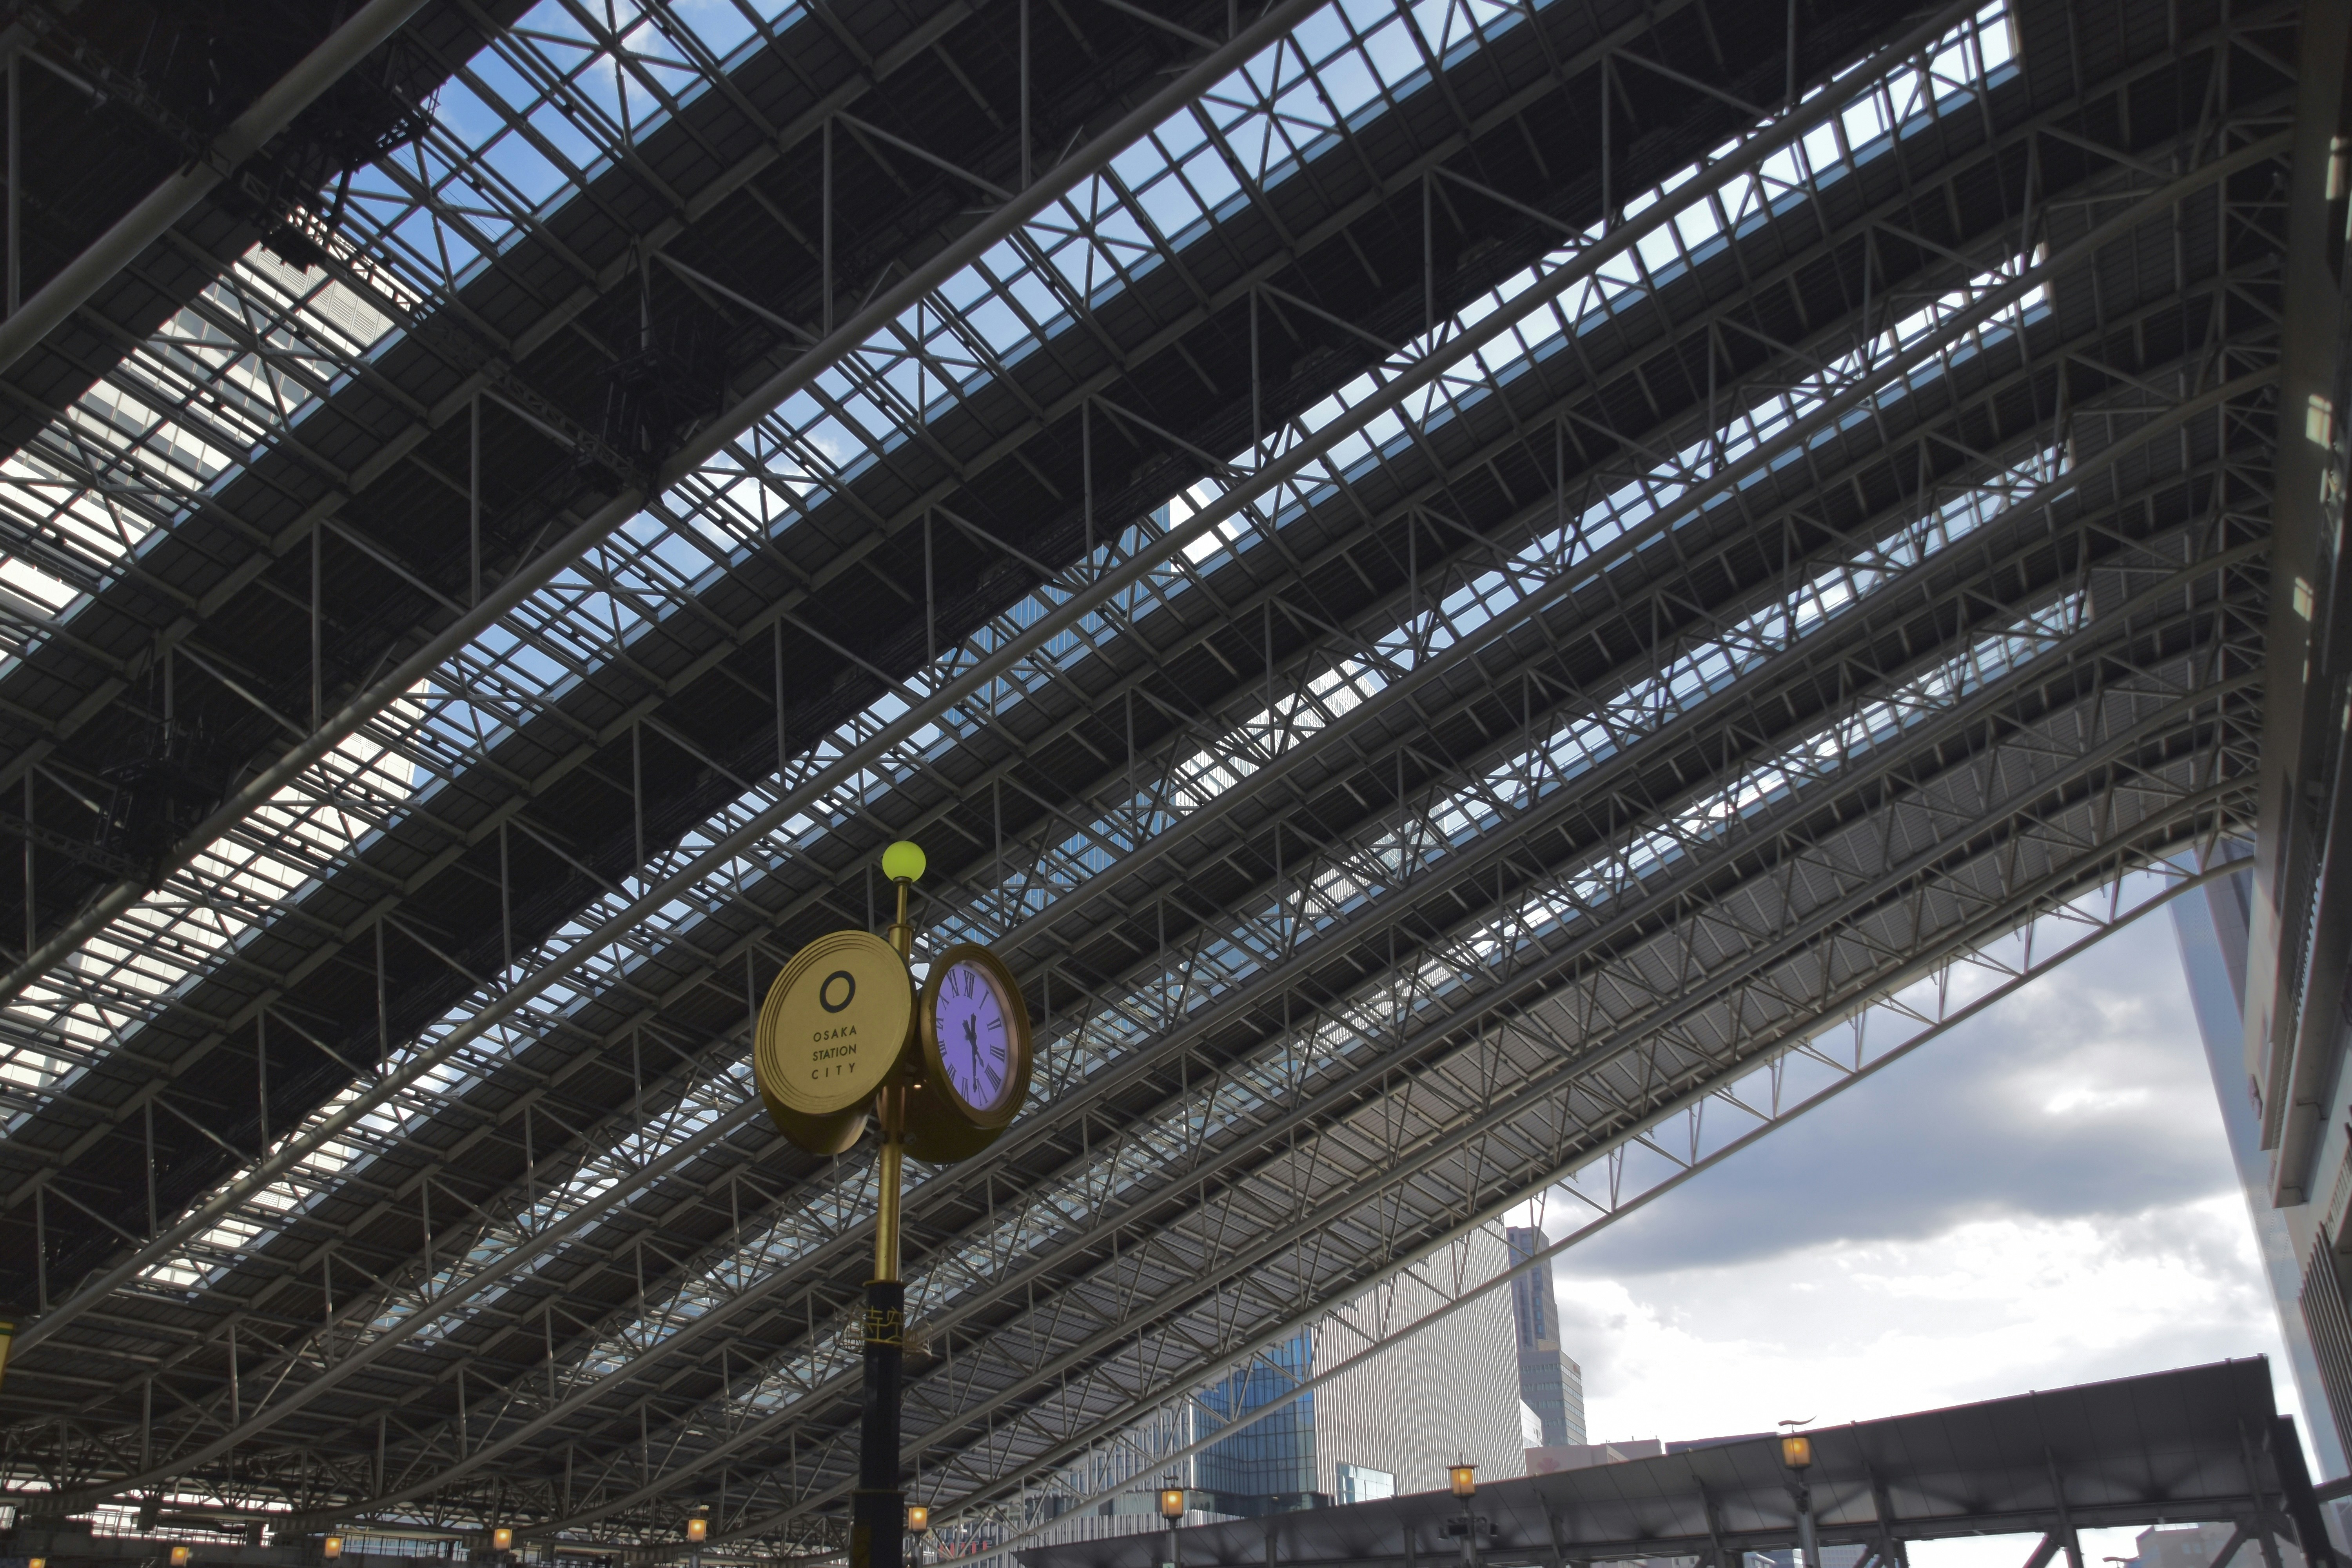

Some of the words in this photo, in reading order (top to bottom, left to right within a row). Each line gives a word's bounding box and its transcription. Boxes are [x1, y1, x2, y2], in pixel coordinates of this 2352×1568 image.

[963, 969, 975, 1000] XII
[979, 989, 989, 1011] I
[813, 1025, 857, 1042] OSAKA
[986, 1016, 1002, 1033] II
[813, 1044, 857, 1061] STATION
[989, 1044, 1005, 1063] III
[811, 1062, 855, 1080] CITY
